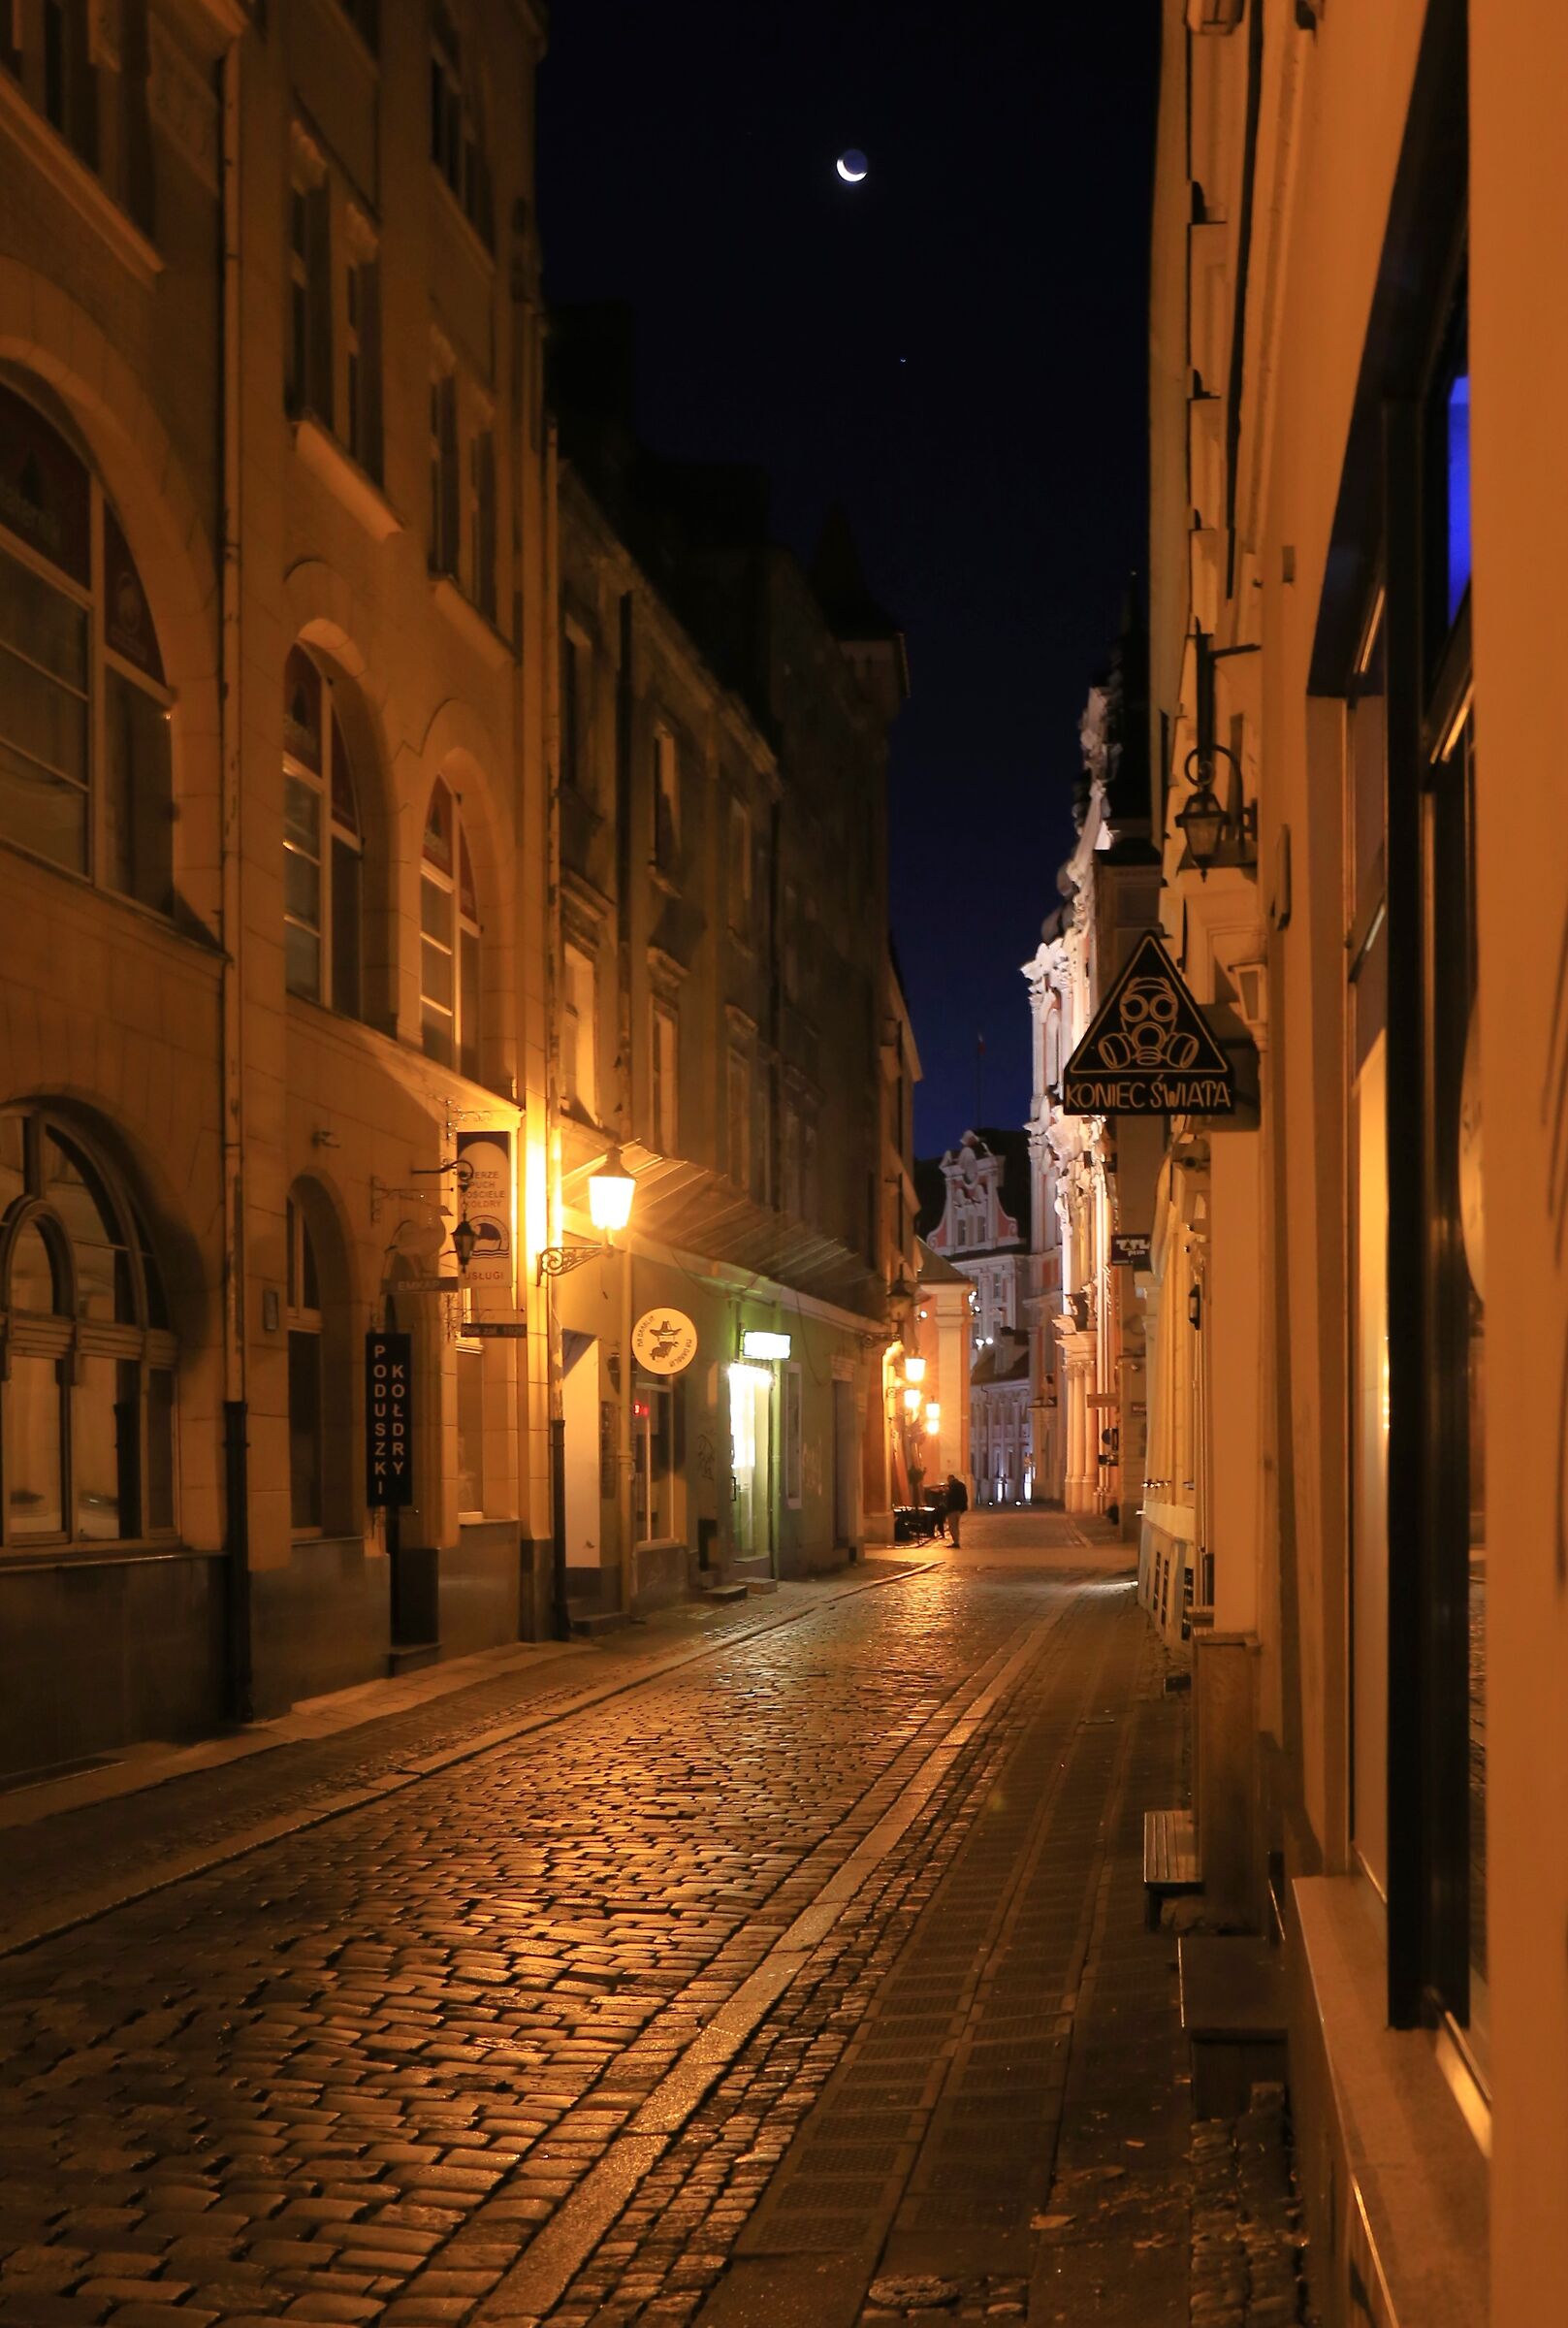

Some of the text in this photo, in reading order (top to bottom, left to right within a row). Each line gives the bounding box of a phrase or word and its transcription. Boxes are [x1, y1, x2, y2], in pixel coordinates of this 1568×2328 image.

[1067, 1074, 1231, 1109] KONIEC ŚWIATA
[373, 1344, 387, 1495] PODUSZKI
[391, 1365, 405, 1475] KOŁDRY
